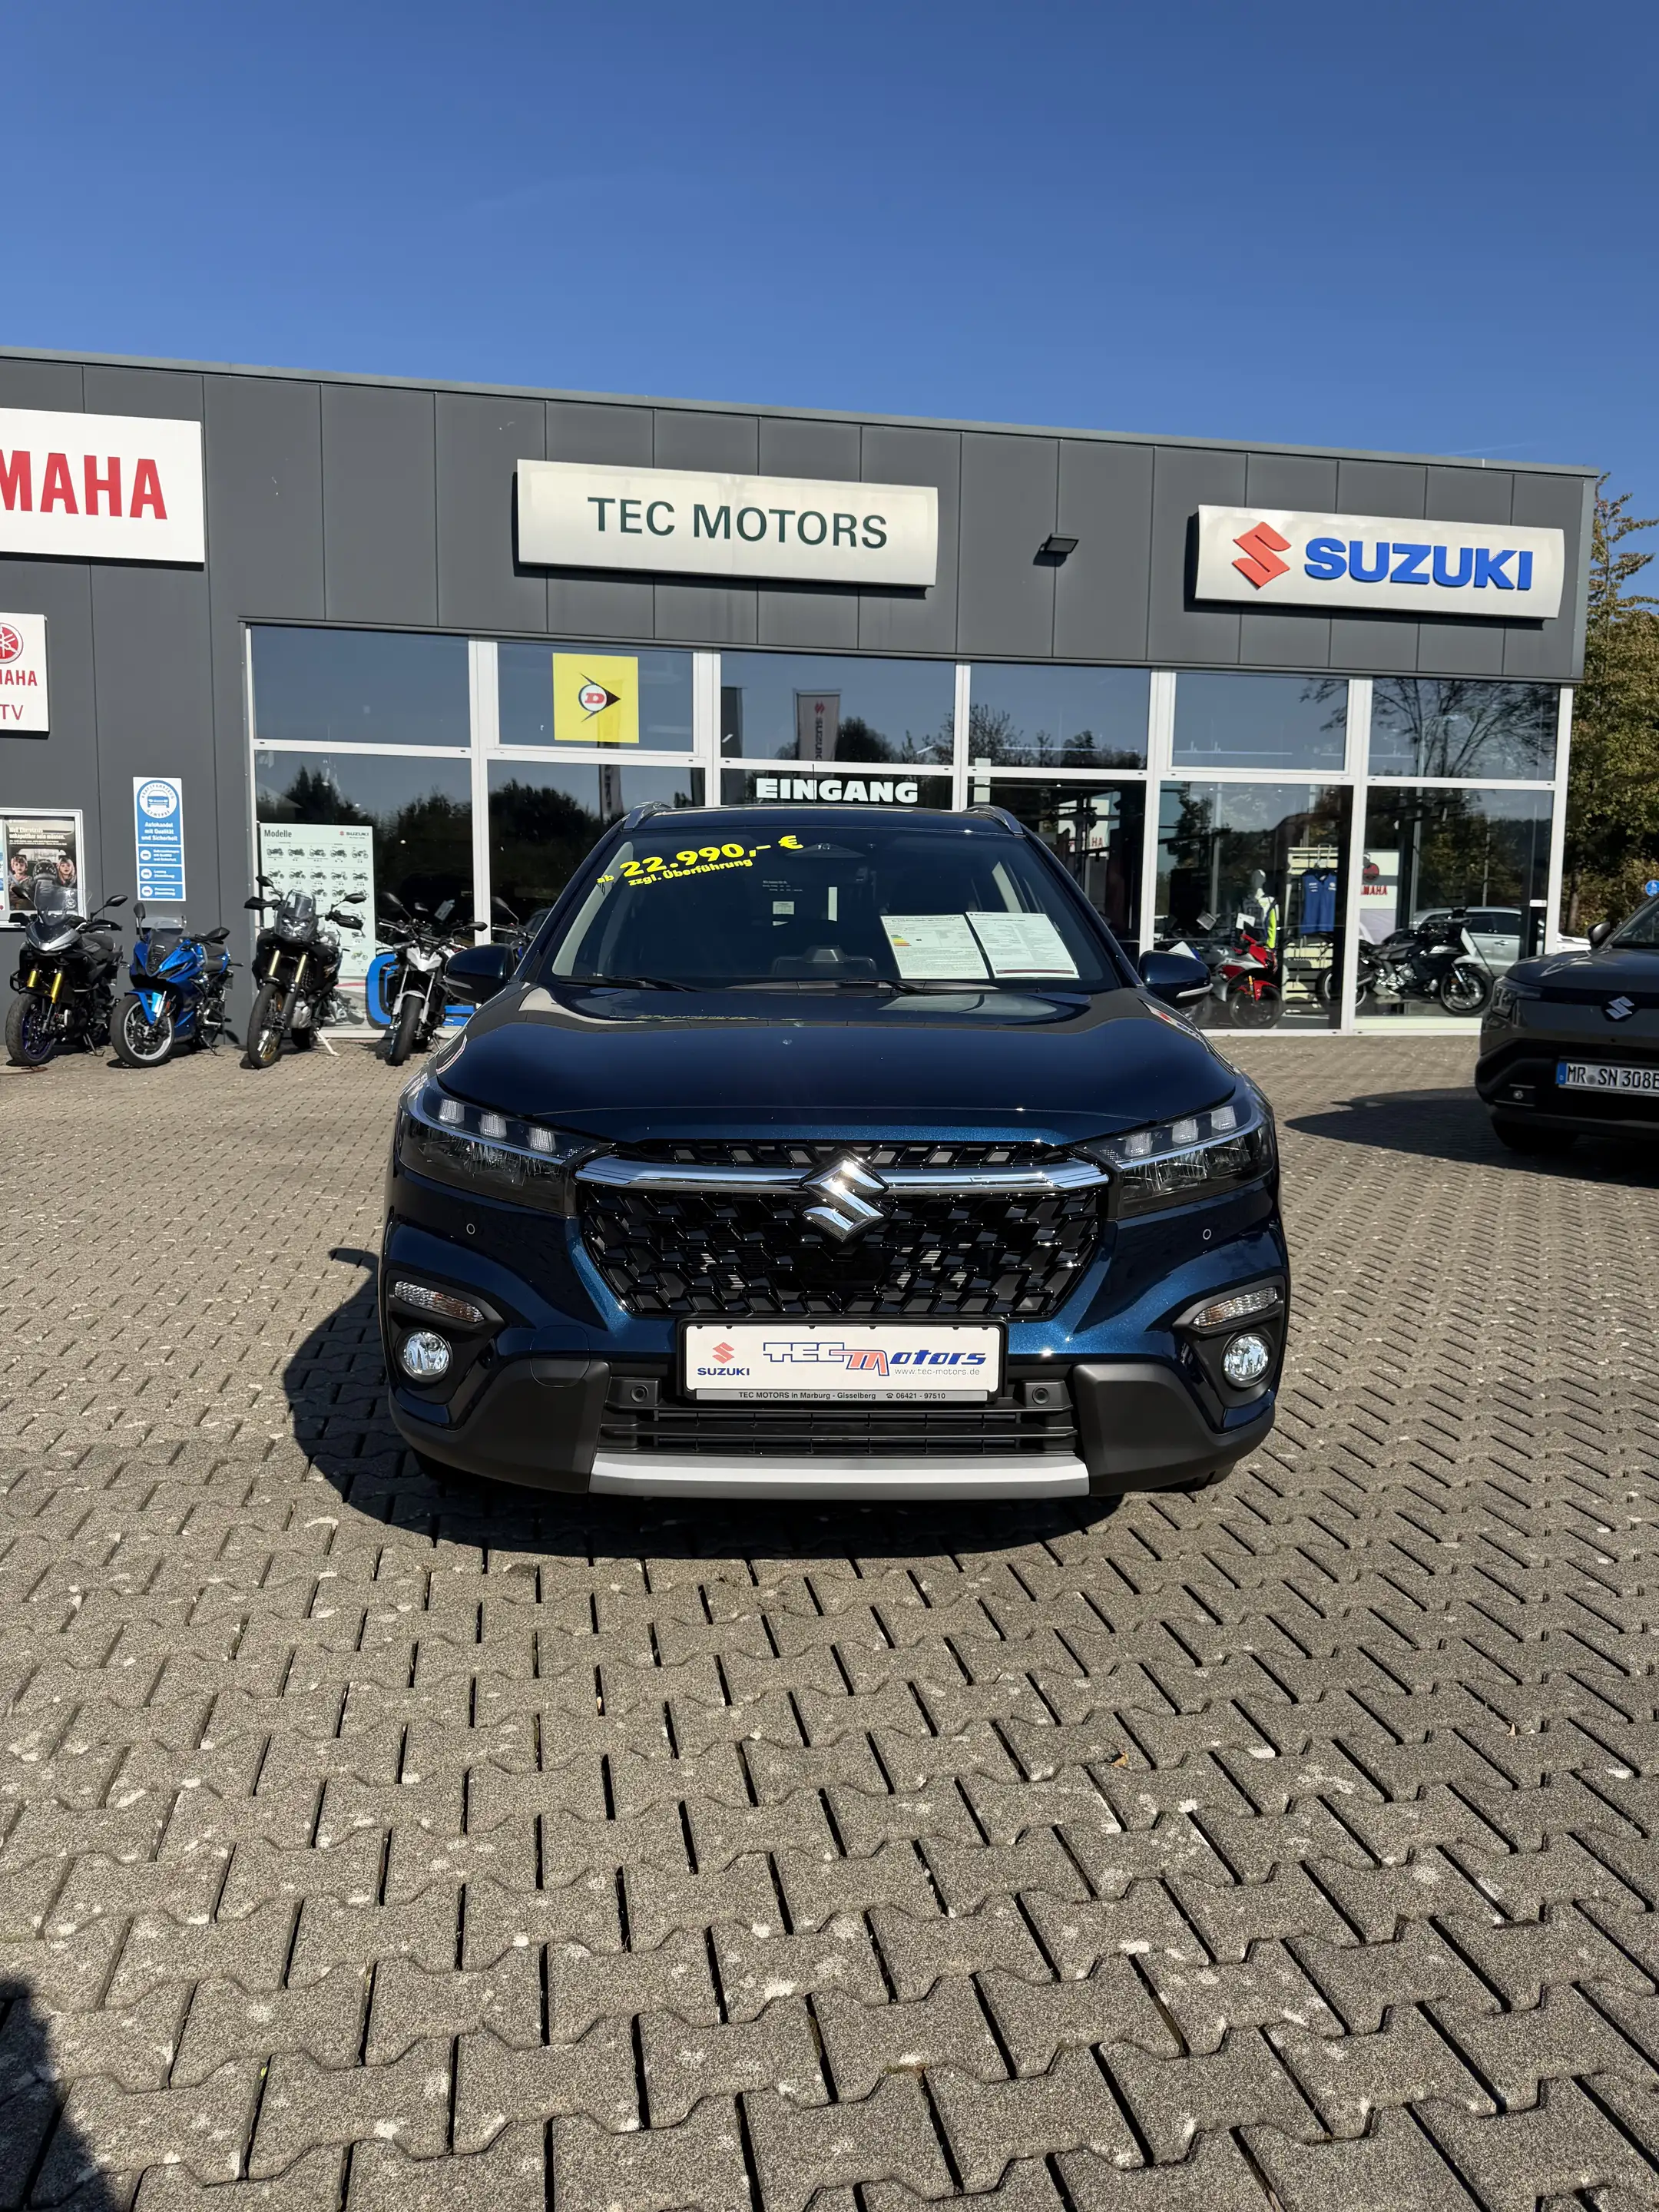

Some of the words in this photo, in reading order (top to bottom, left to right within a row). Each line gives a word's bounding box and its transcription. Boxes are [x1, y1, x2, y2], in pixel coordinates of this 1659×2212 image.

[0, 449, 167, 520] MAHA
[587, 496, 675, 536] TEC
[694, 504, 888, 549] MOTORS
[1304, 537, 1534, 591] SUZUKI
[756, 778, 919, 803] EINGANG
[264, 830, 293, 838] Modelle
[596, 874, 614, 884] ab
[778, 835, 804, 850] €
[628, 871, 662, 886] zzgl.
[663, 858, 753, 879] Überführung
[1568, 1065, 1587, 1083] MR
[1598, 1068, 1618, 1086] SN
[697, 1367, 750, 1376] SUZUKI
[800, 1392, 830, 1400] Marburg
[837, 1392, 876, 1400] Gisselberg
